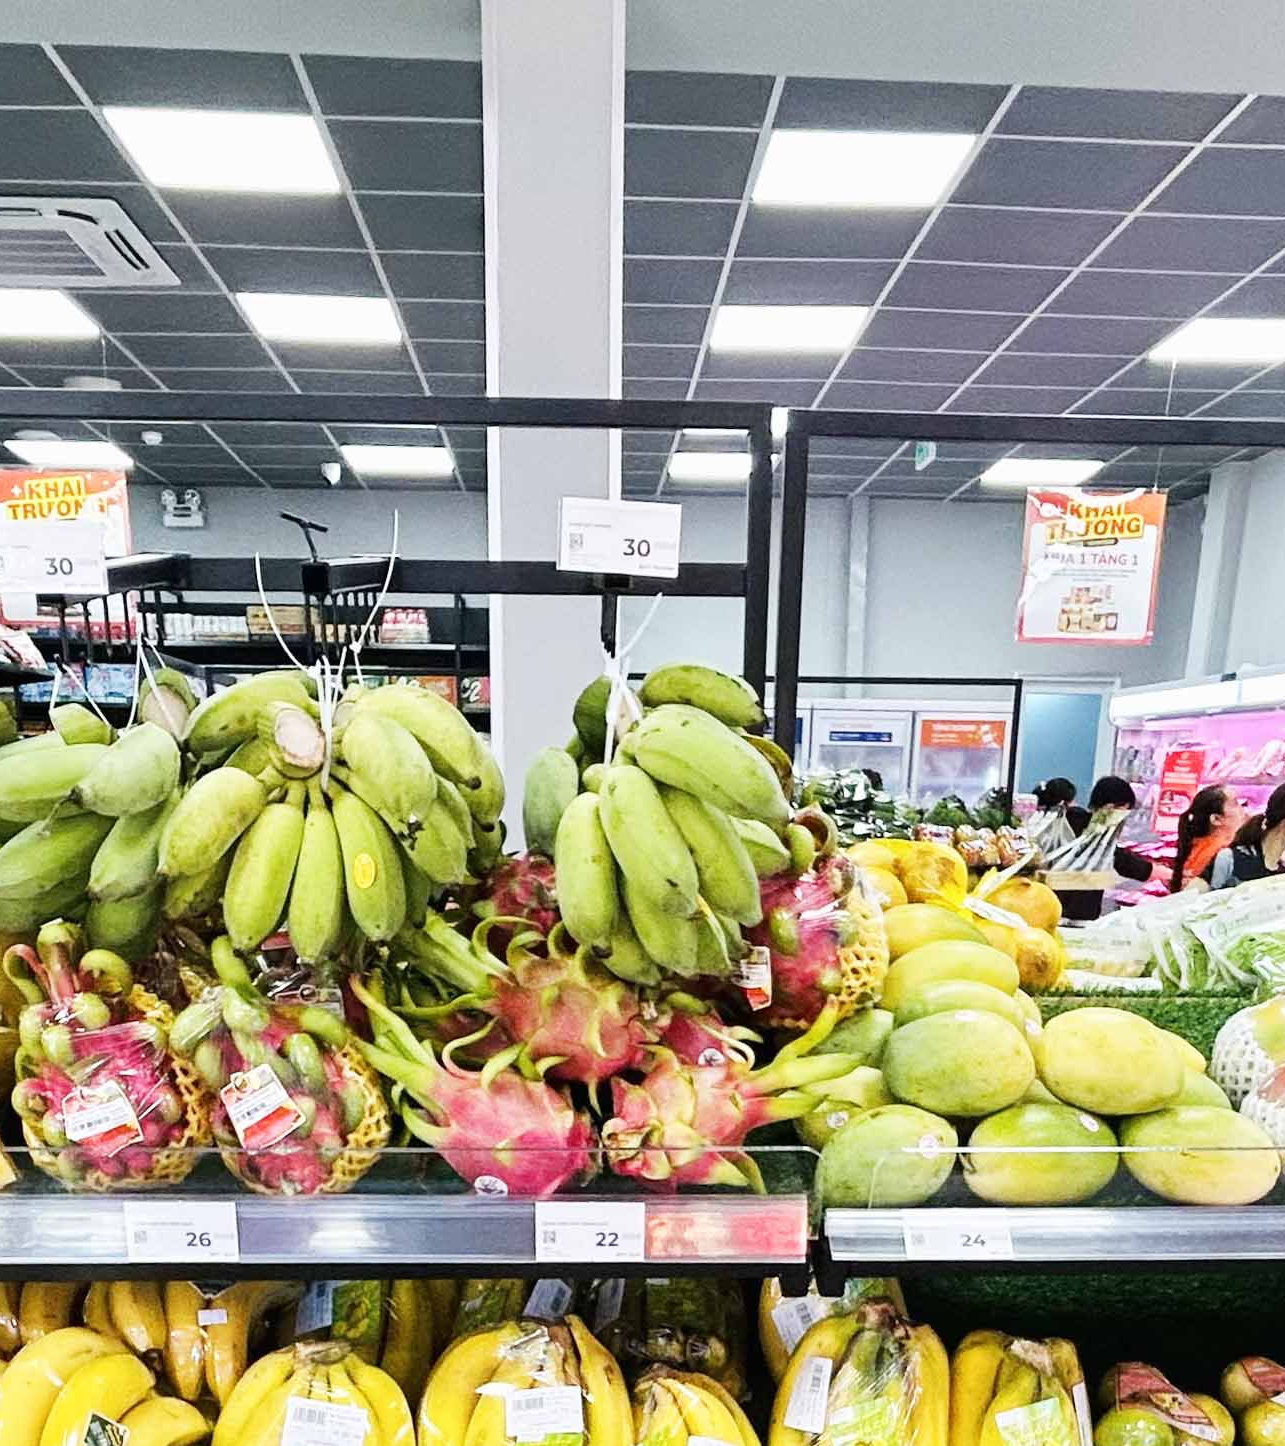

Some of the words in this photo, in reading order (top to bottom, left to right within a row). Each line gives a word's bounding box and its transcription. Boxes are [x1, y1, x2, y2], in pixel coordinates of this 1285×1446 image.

[27, 480, 82, 499] KHAI
[623, 538, 651, 557] 30
[44, 557, 73, 576] 30
[186, 1232, 212, 1247] 26
[595, 1232, 619, 1247] 22
[960, 1233, 986, 1247] 24
